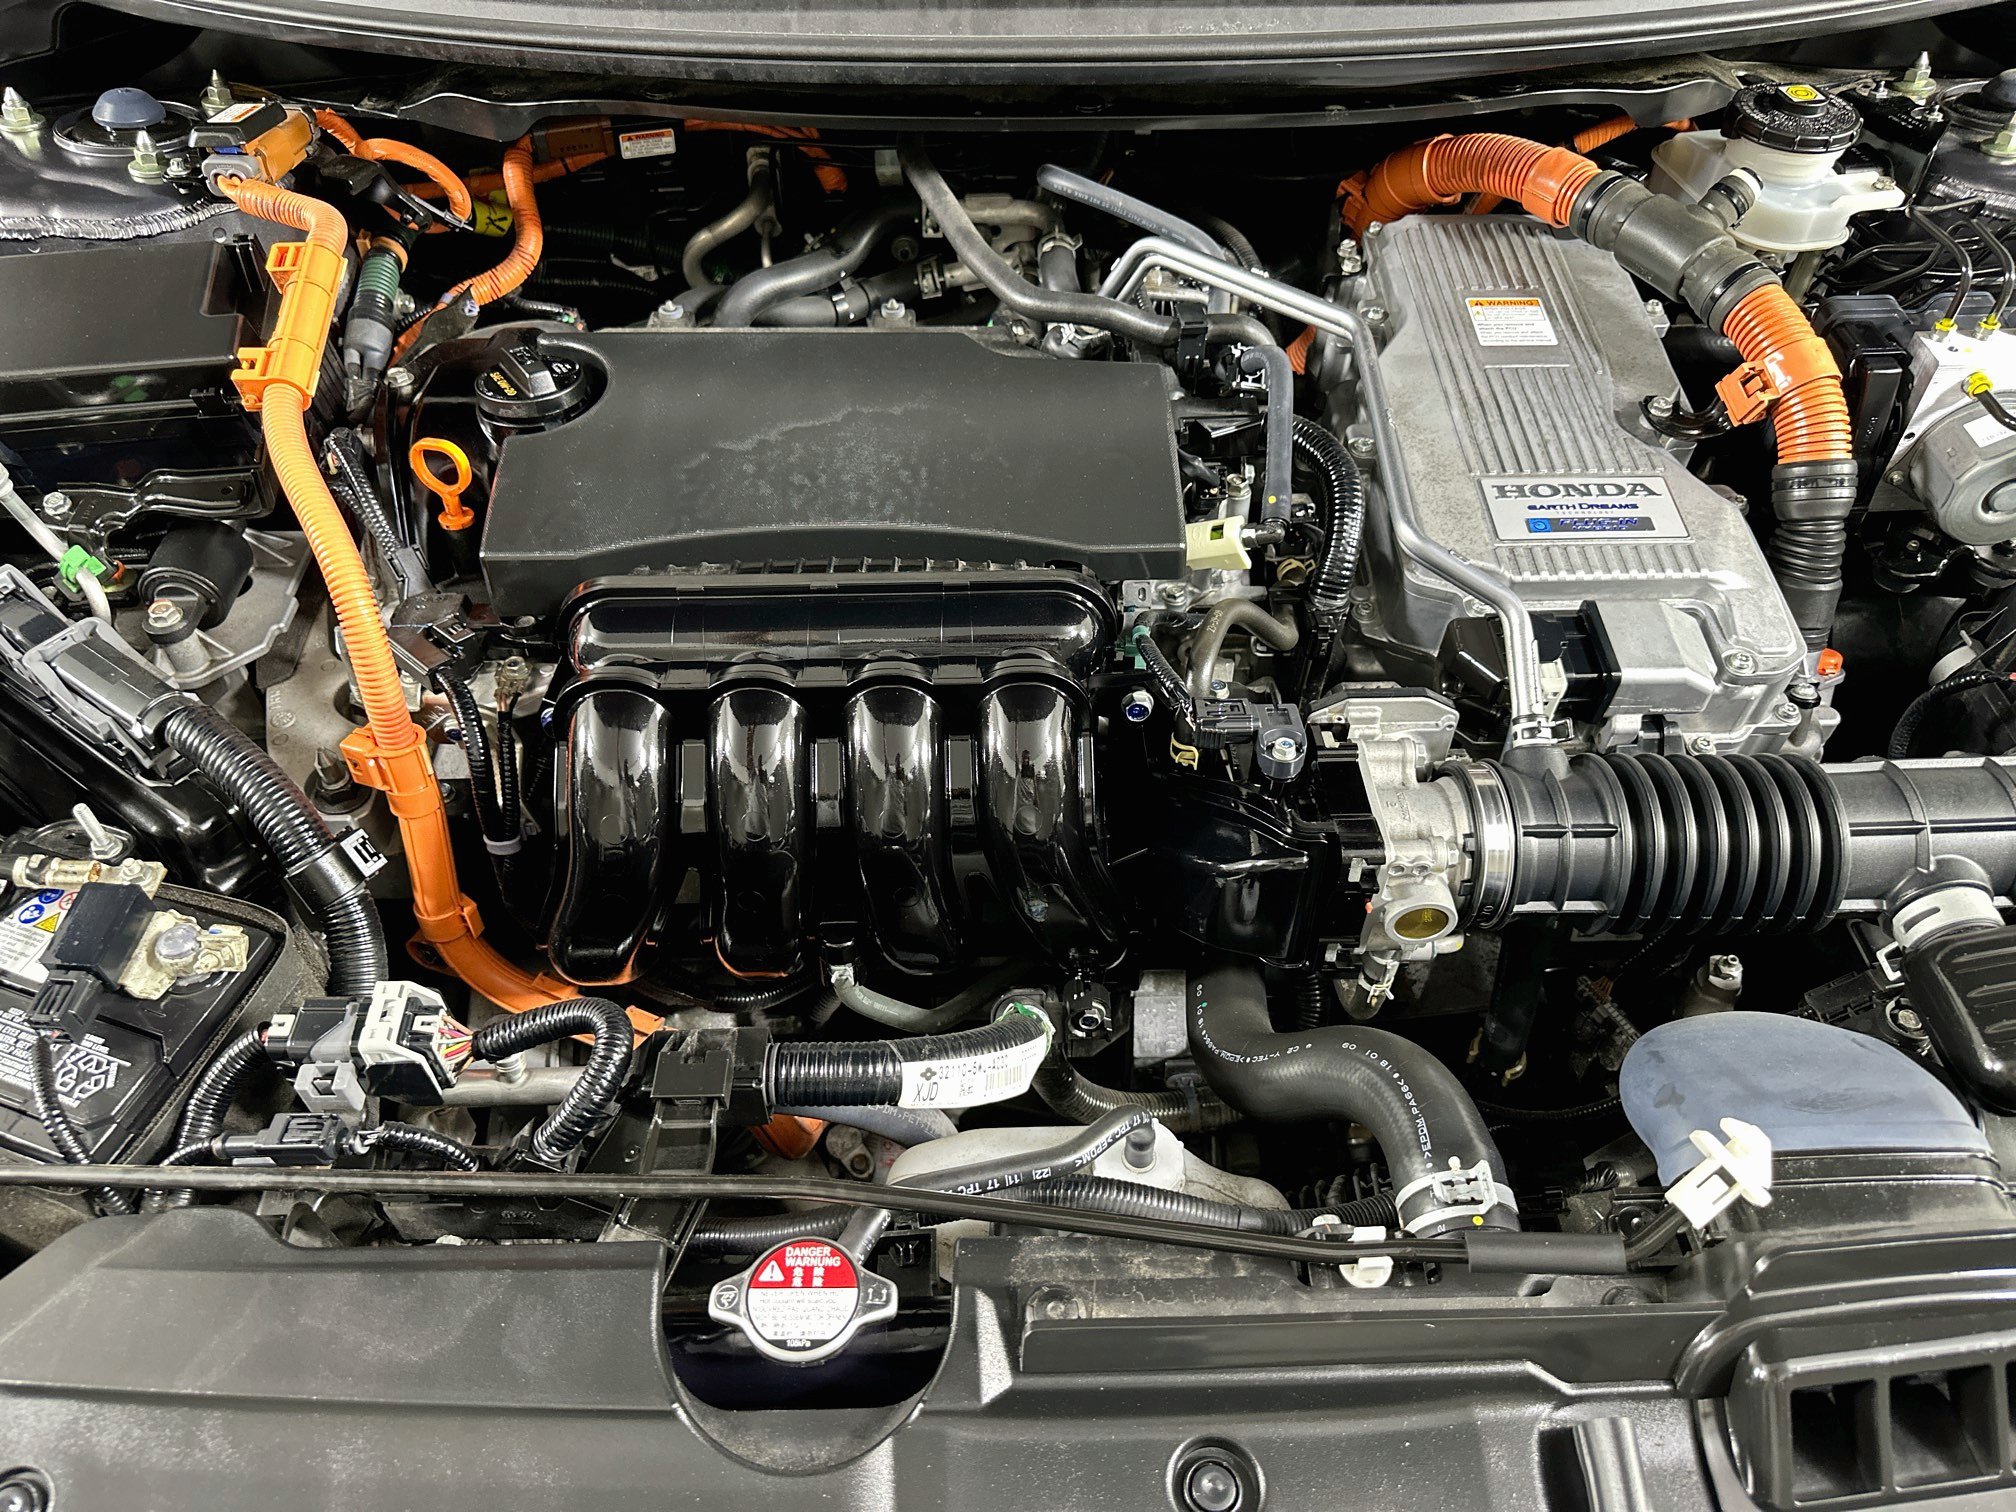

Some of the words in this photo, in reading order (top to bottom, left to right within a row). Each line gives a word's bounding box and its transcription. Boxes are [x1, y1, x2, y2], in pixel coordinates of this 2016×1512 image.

[1491, 482, 1663, 500] HONDA
[1527, 503, 1577, 511] EARTH
[1578, 502, 1640, 510] DREAMS
[1558, 517, 1639, 525] PLUG-IN
[913, 1082, 939, 1103] XJD
[1114, 1123, 1132, 1140] TPC
[1074, 1136, 1114, 1168] >EPDM<
[957, 1183, 982, 1195] TPC
[986, 1178, 1000, 1191] 17
[785, 1246, 831, 1257] DANGER
[785, 1256, 841, 1267] WARNUNG
